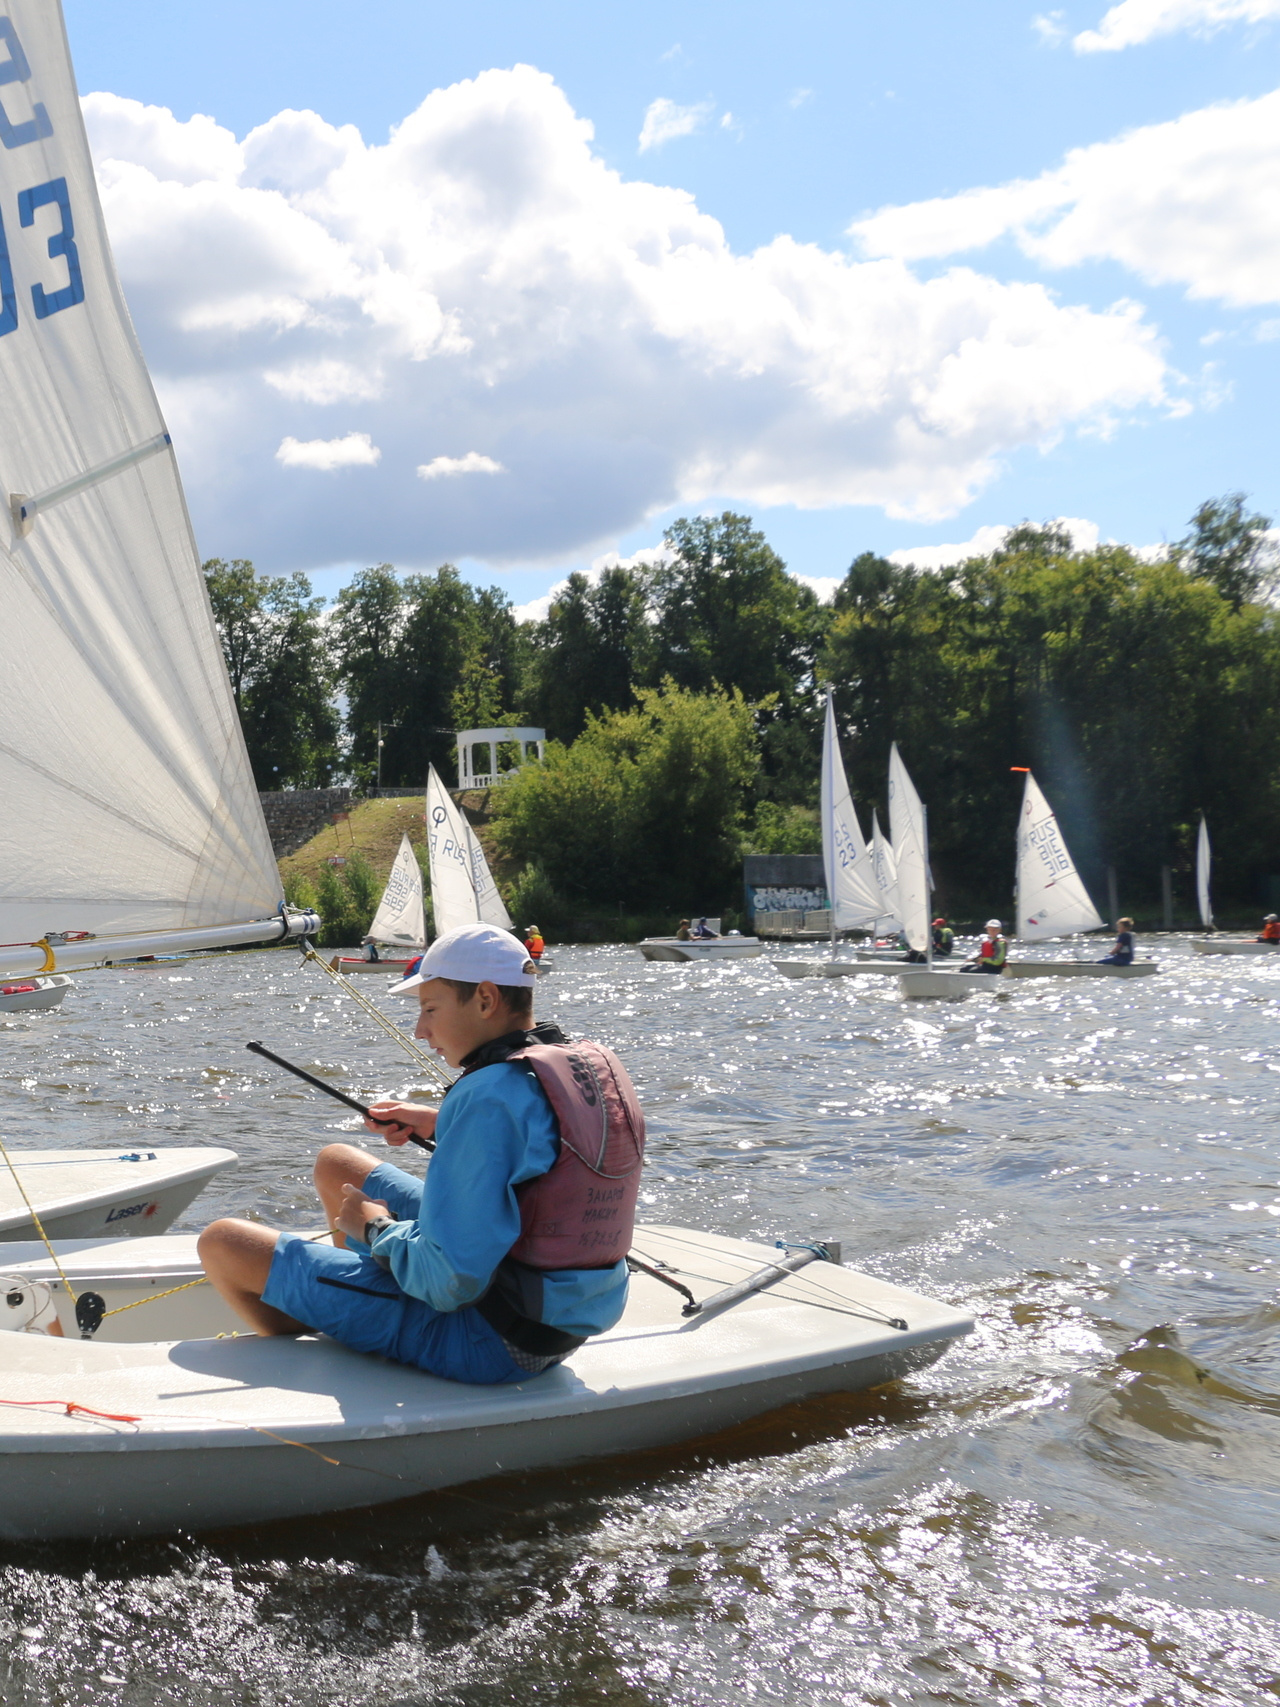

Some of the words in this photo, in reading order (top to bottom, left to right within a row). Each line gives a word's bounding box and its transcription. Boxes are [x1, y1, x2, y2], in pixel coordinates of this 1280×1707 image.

[1029, 820, 1056, 847] RUS
[839, 842, 857, 869] 23
[104, 1201, 149, 1224] Laser
